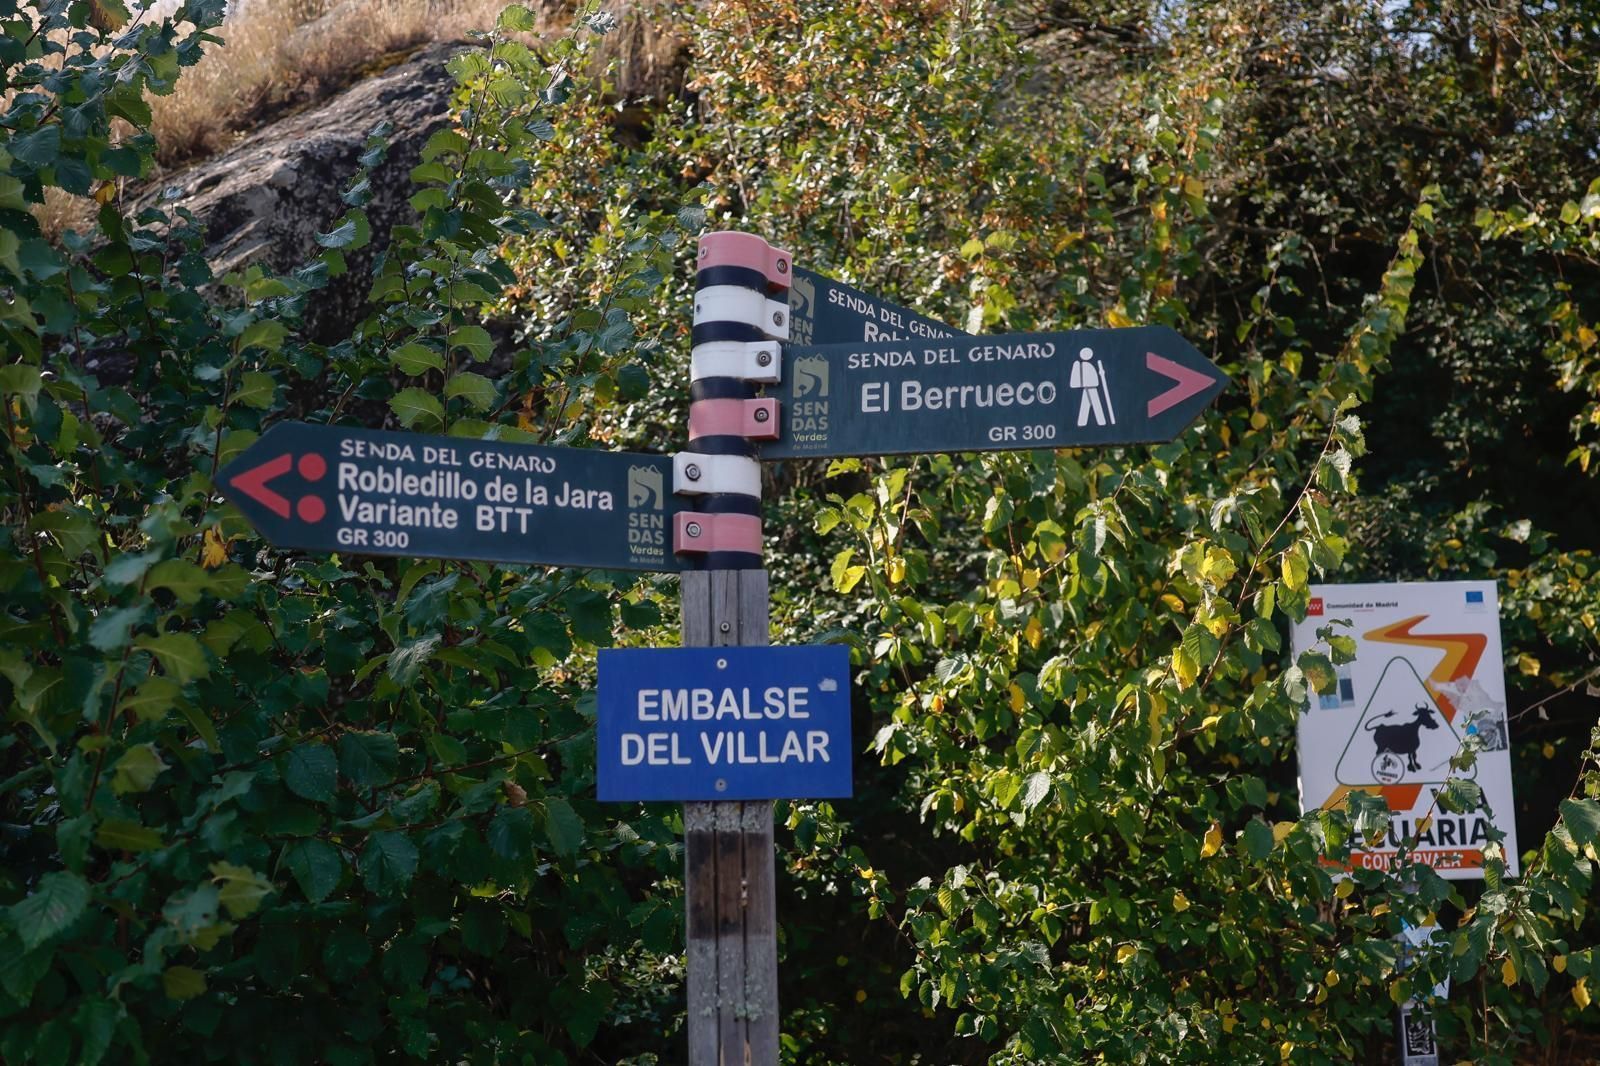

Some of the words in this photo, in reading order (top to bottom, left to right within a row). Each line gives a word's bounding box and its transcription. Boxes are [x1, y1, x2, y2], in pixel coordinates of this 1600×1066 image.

[828, 288, 876, 318] SENDA
[880, 308, 904, 329] DEL
[848, 350, 917, 369] SENDA
[924, 348, 960, 365] DEL
[968, 342, 1055, 363] GENARO
[792, 401, 829, 416] SEN
[861, 382, 890, 413] El
[901, 380, 1056, 411] Berrueco
[791, 416, 829, 432] DAS
[988, 426, 1017, 442] GR
[1022, 424, 1056, 441] 300
[793, 432, 828, 442] Verdes
[340, 439, 416, 462] SENDA
[423, 446, 462, 466] DEL
[469, 451, 556, 474] GENARO
[338, 462, 478, 500] Robledillo
[484, 475, 518, 503] de
[526, 477, 548, 506] la
[555, 481, 613, 511] Jara
[338, 493, 458, 529] Variante
[476, 504, 533, 534] BTT
[628, 512, 664, 529] SEN
[337, 527, 368, 546] GR
[373, 530, 409, 548] 300
[628, 528, 664, 545] DAS
[629, 544, 664, 556] Verdes
[638, 687, 810, 722] EMBALSE
[621, 731, 692, 765] DEL
[700, 730, 831, 765] VILLAR
